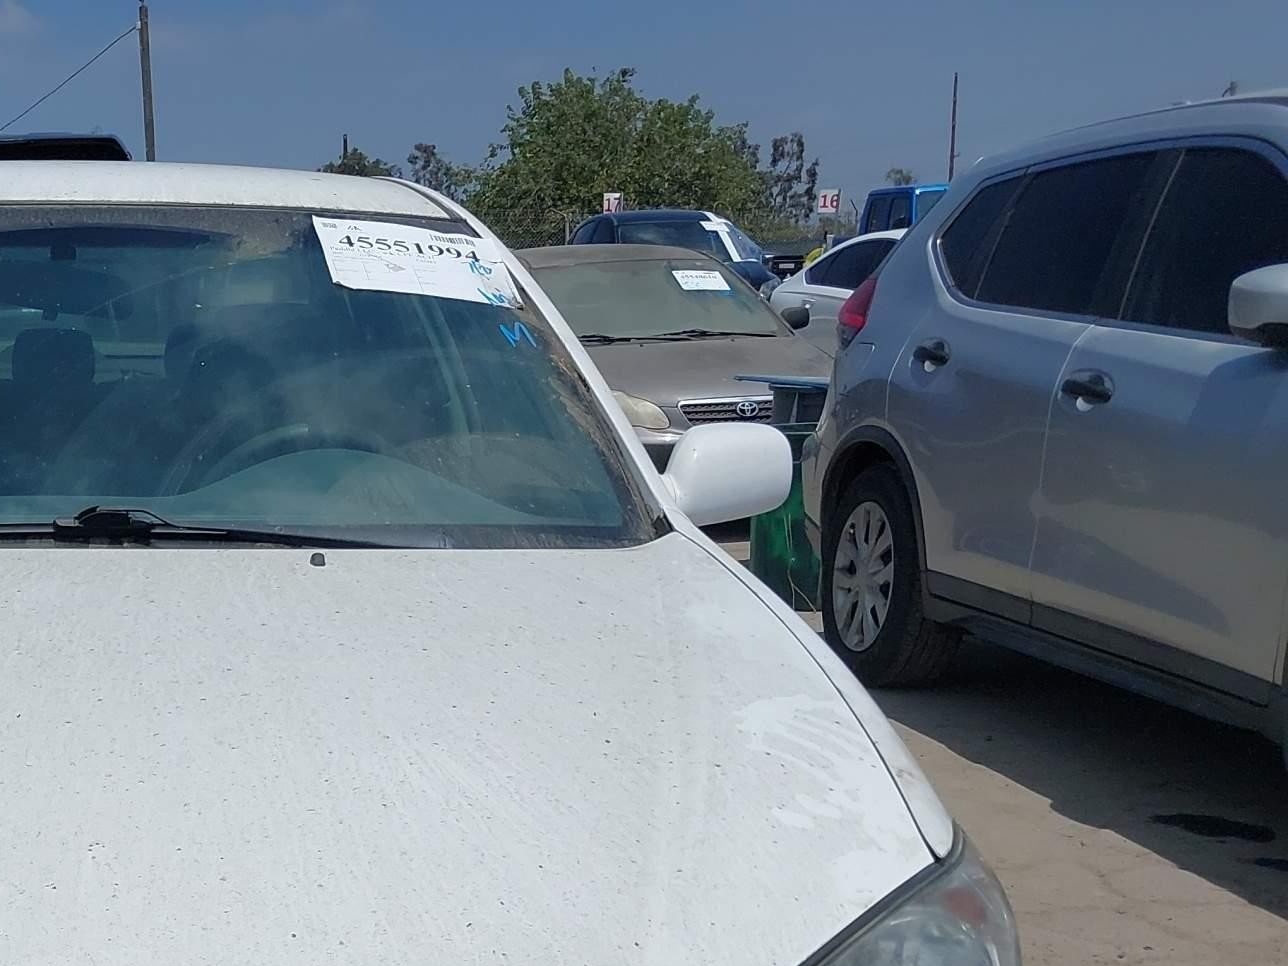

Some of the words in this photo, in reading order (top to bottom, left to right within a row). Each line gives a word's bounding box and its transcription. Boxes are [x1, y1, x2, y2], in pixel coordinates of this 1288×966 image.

[605, 198, 620, 213] 17
[820, 194, 840, 209] 16
[338, 235, 480, 263] 45551994
[499, 321, 537, 348] M
